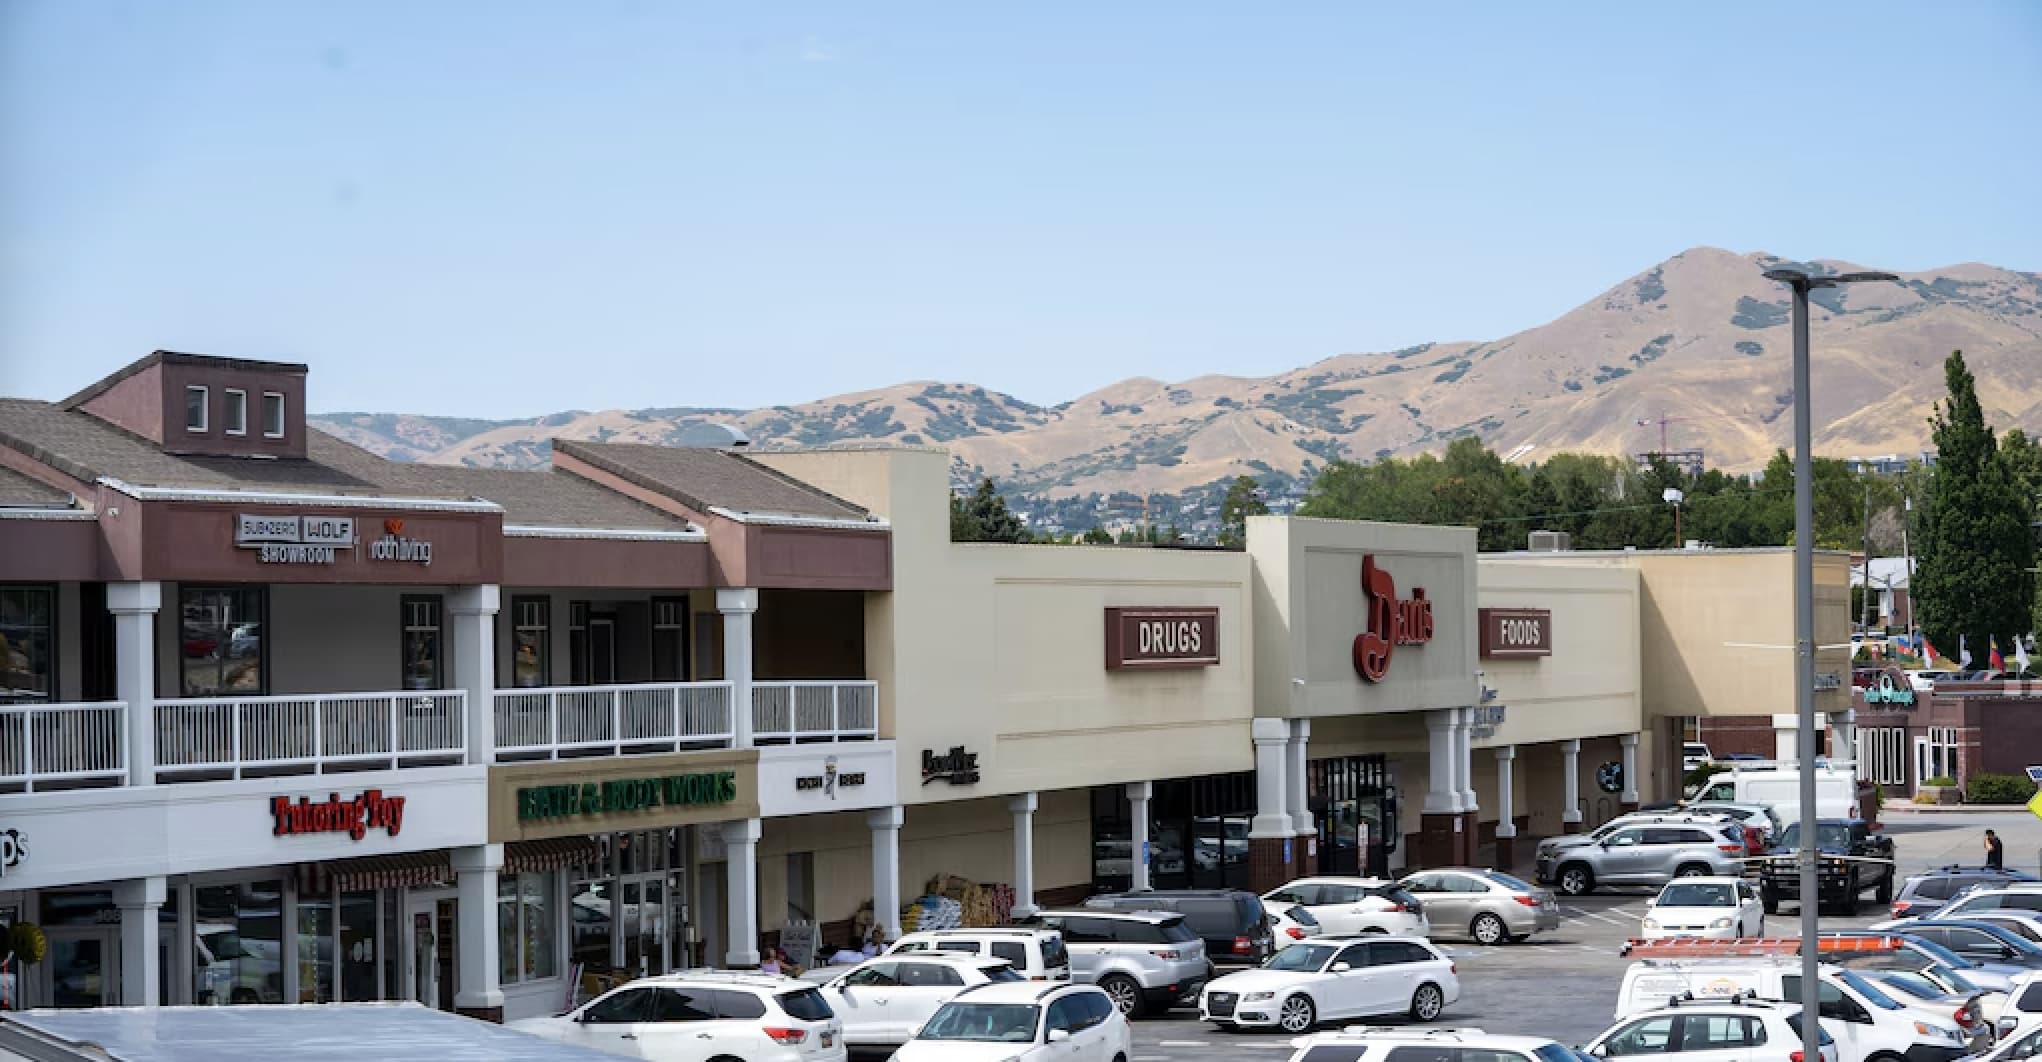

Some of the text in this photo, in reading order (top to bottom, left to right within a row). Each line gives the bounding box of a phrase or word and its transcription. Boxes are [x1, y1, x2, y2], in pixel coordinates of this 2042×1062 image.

[307, 521, 349, 539] WOLF
[261, 544, 335, 563] SHOWROOM
[1139, 621, 1201, 653] DRUGS
[1501, 619, 1540, 646] FOODS
[518, 784, 580, 819] BATH
[602, 779, 662, 811] BODY
[663, 771, 736, 804] WORKS
[270, 790, 406, 840] Tutoring Toy
